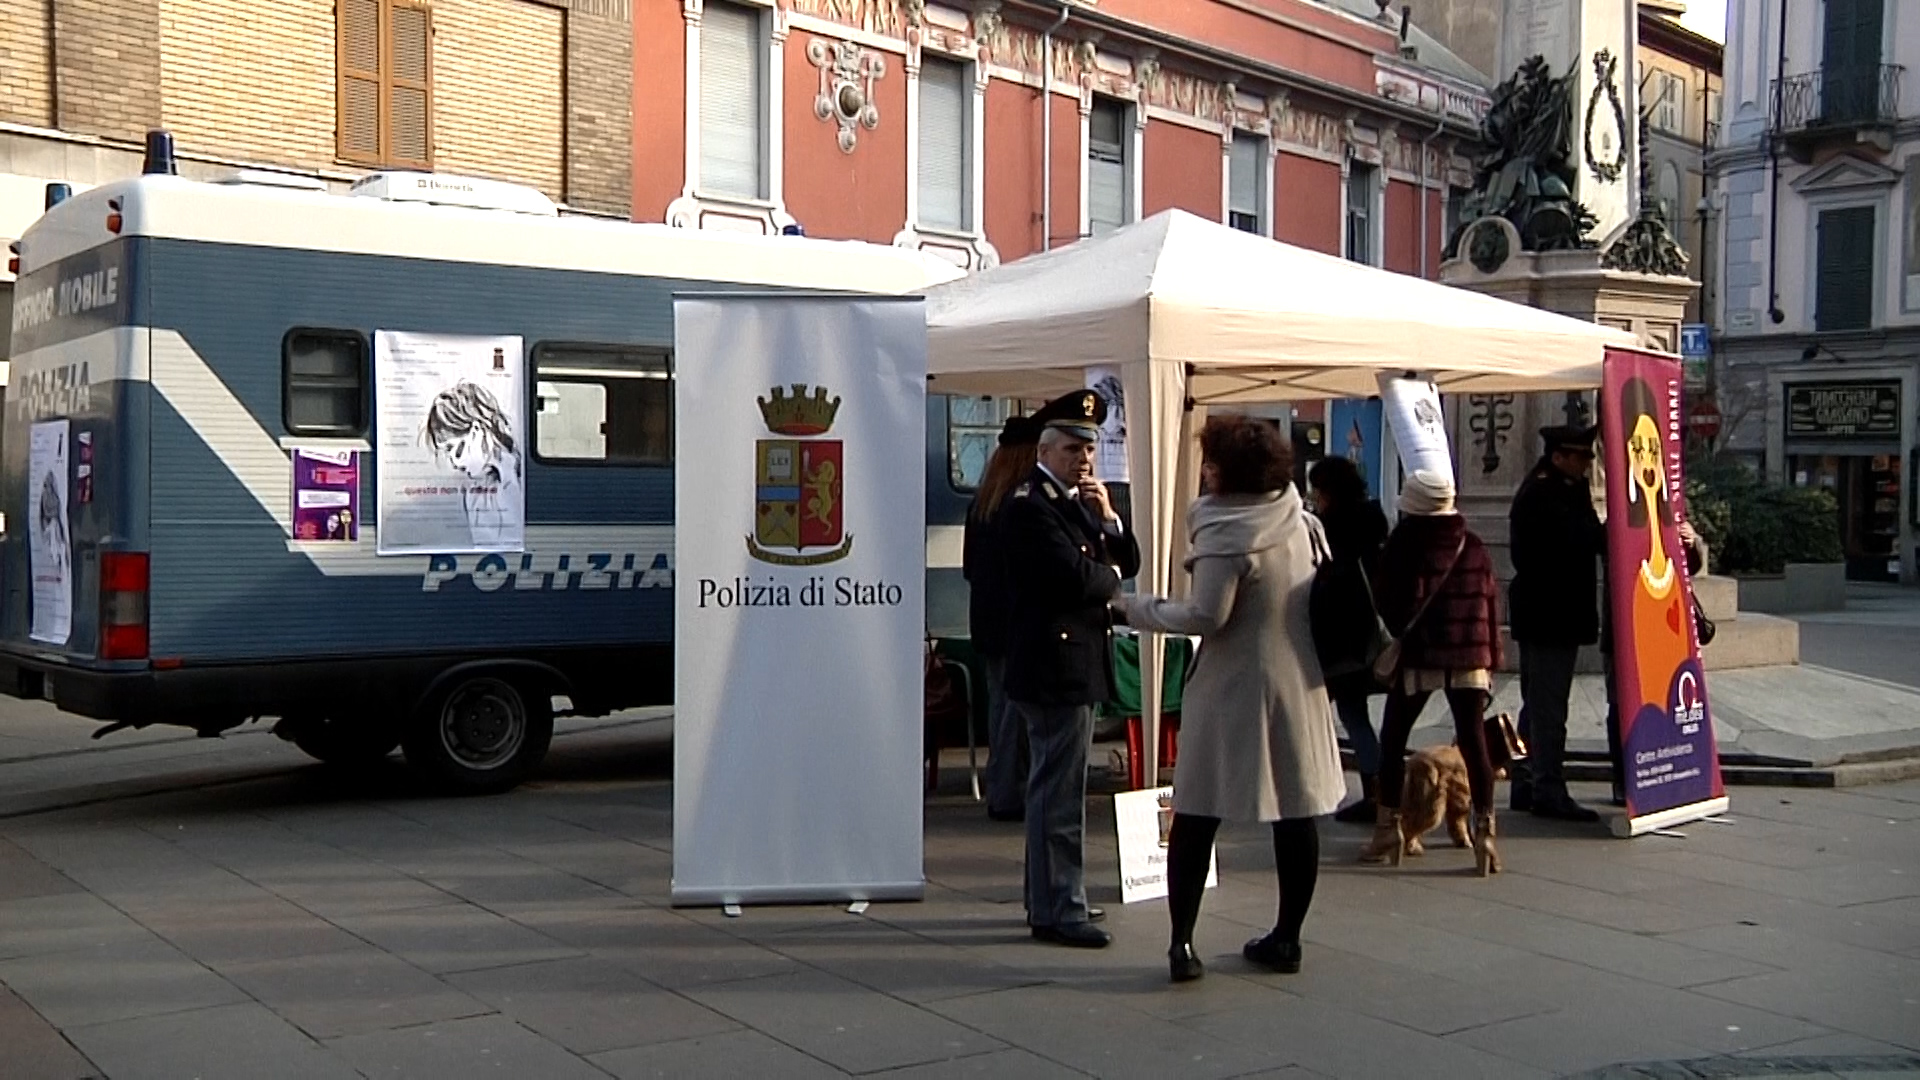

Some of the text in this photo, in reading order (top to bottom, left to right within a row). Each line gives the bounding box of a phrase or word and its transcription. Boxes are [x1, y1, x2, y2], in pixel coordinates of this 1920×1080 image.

[58, 267, 118, 315] MOBILE
[18, 361, 91, 421] POLIZIA
[1670, 452, 1681, 502] SULLE
[422, 553, 672, 592] POLIZIA
[698, 576, 902, 608] Polizia di Stato
